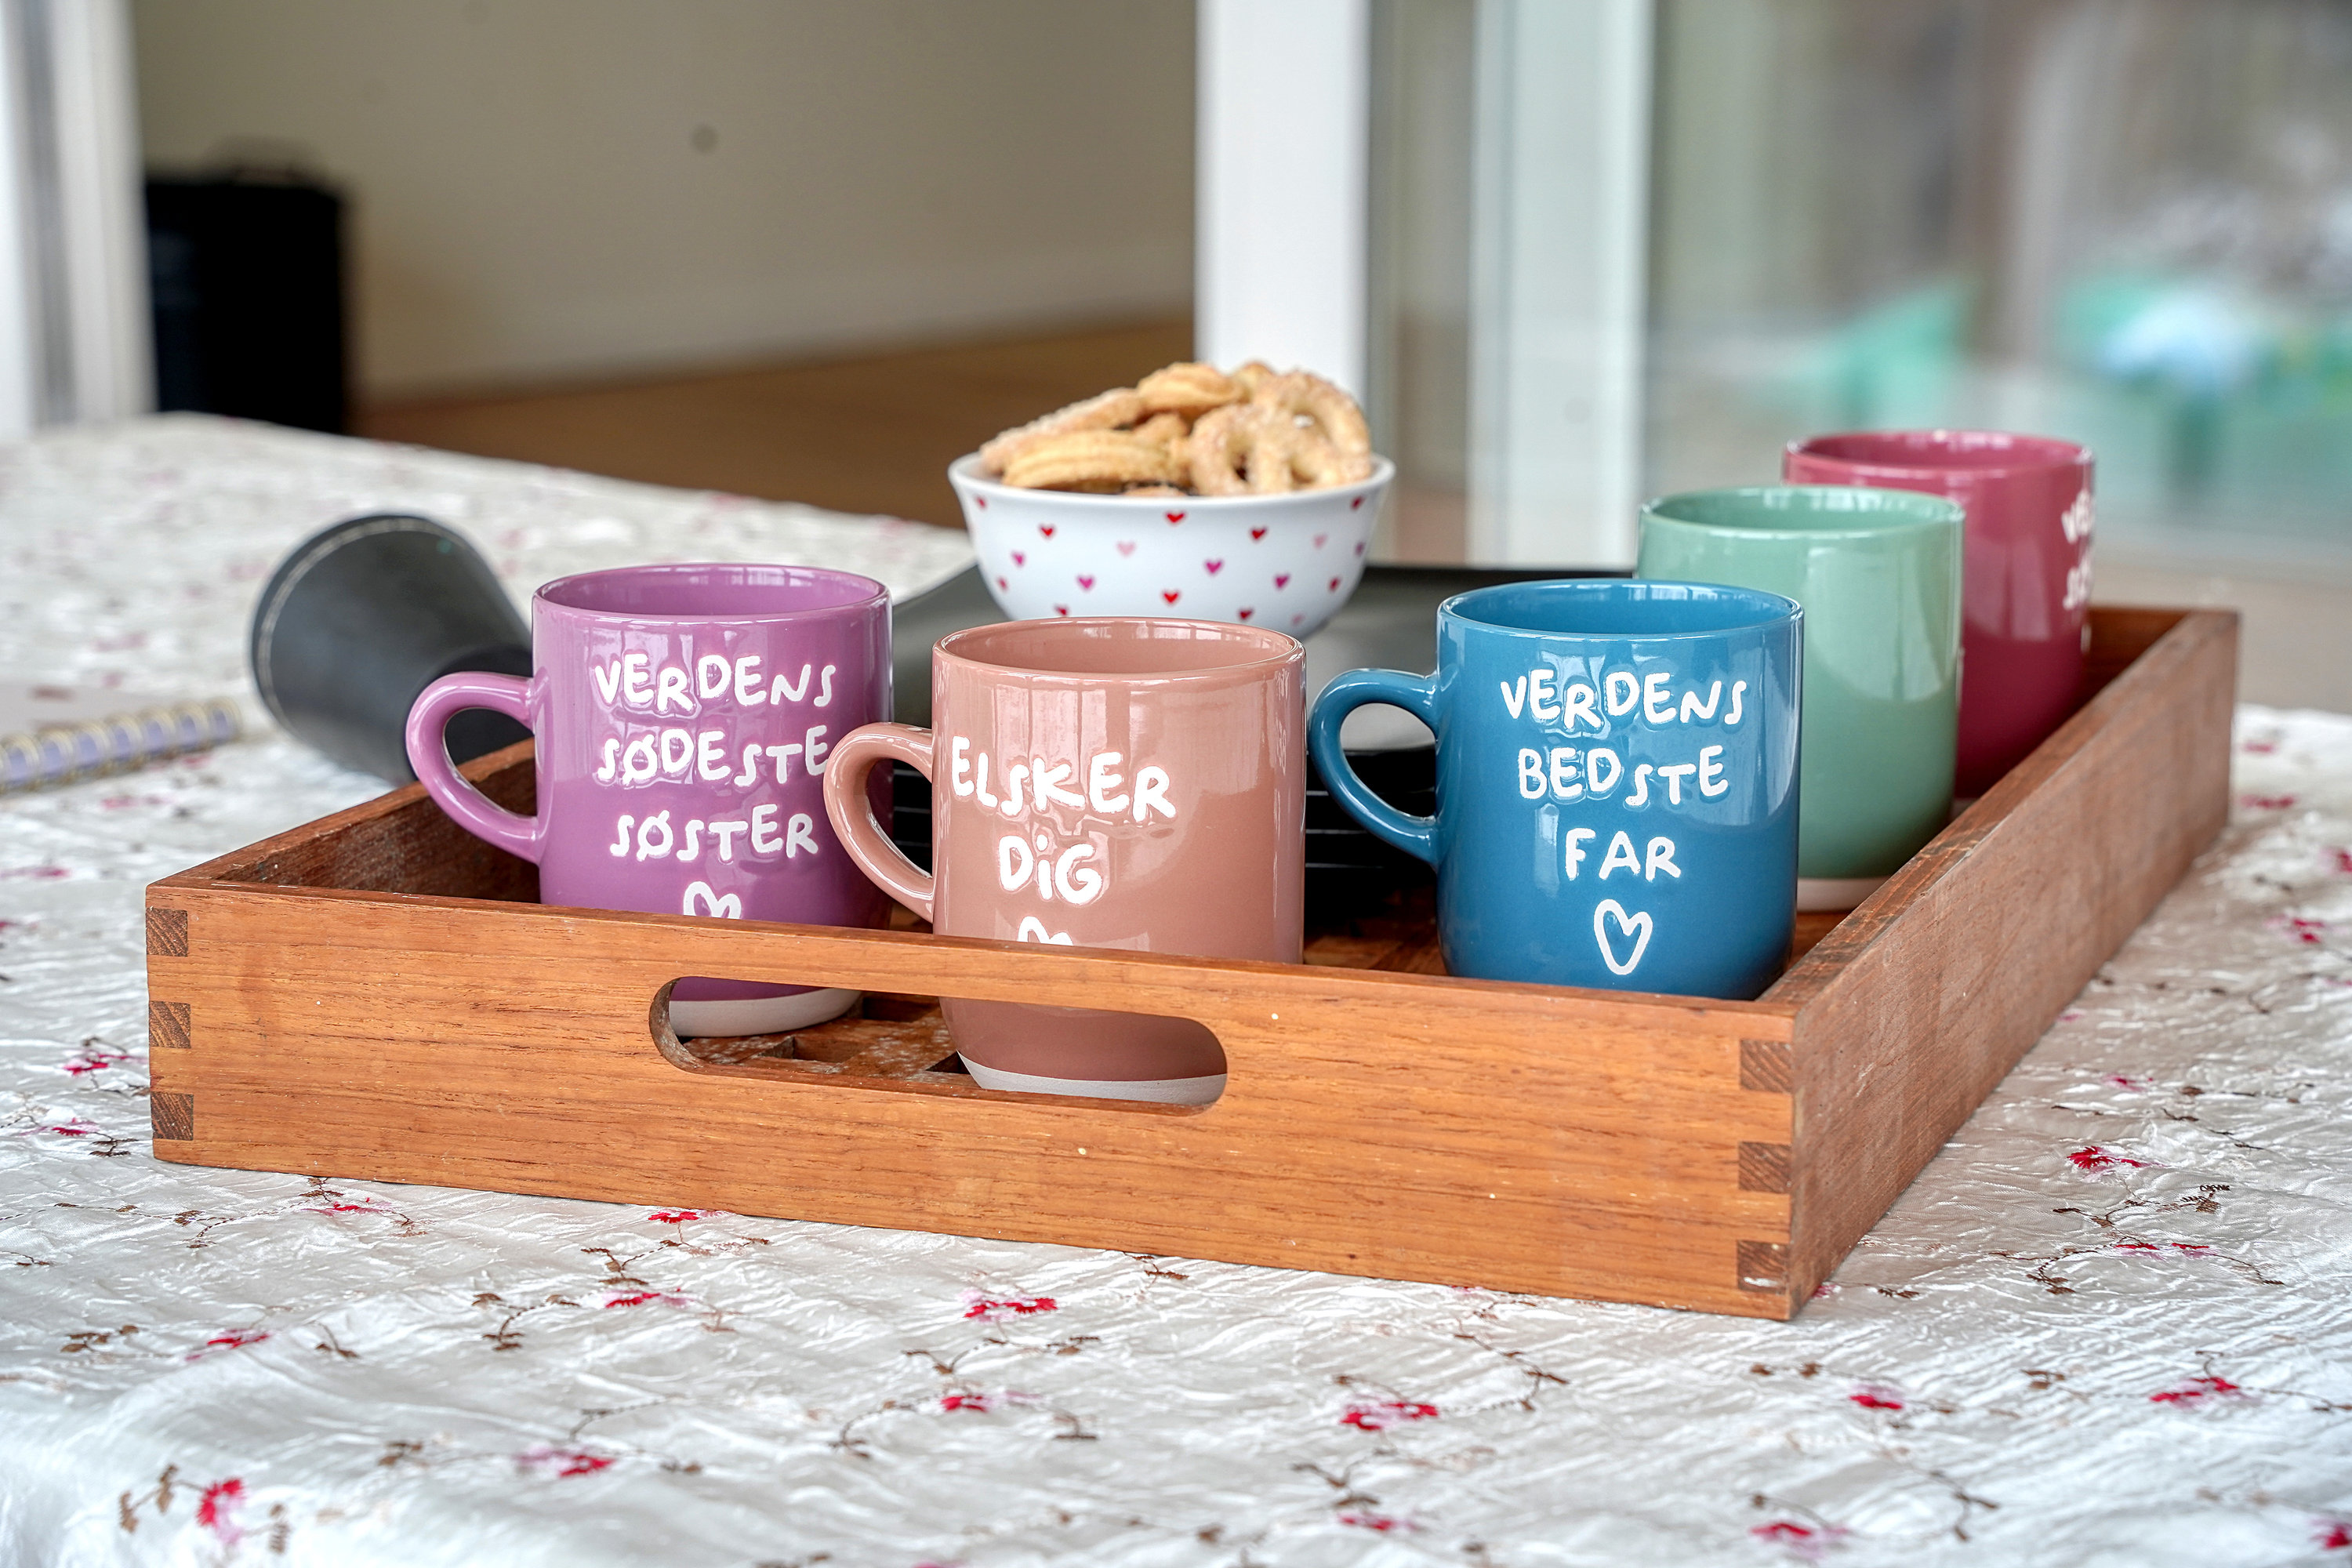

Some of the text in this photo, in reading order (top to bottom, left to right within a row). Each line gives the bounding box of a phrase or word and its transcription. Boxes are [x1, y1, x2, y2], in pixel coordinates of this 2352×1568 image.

[594, 653, 836, 711] VERDENS
[1501, 669, 1747, 728] VERDENS
[597, 724, 829, 786] SØDESTE
[951, 735, 1176, 822] ELSKER
[1519, 745, 1729, 806] BEDSTE
[609, 804, 818, 862] SØSTER
[1566, 828, 1682, 882] FAR
